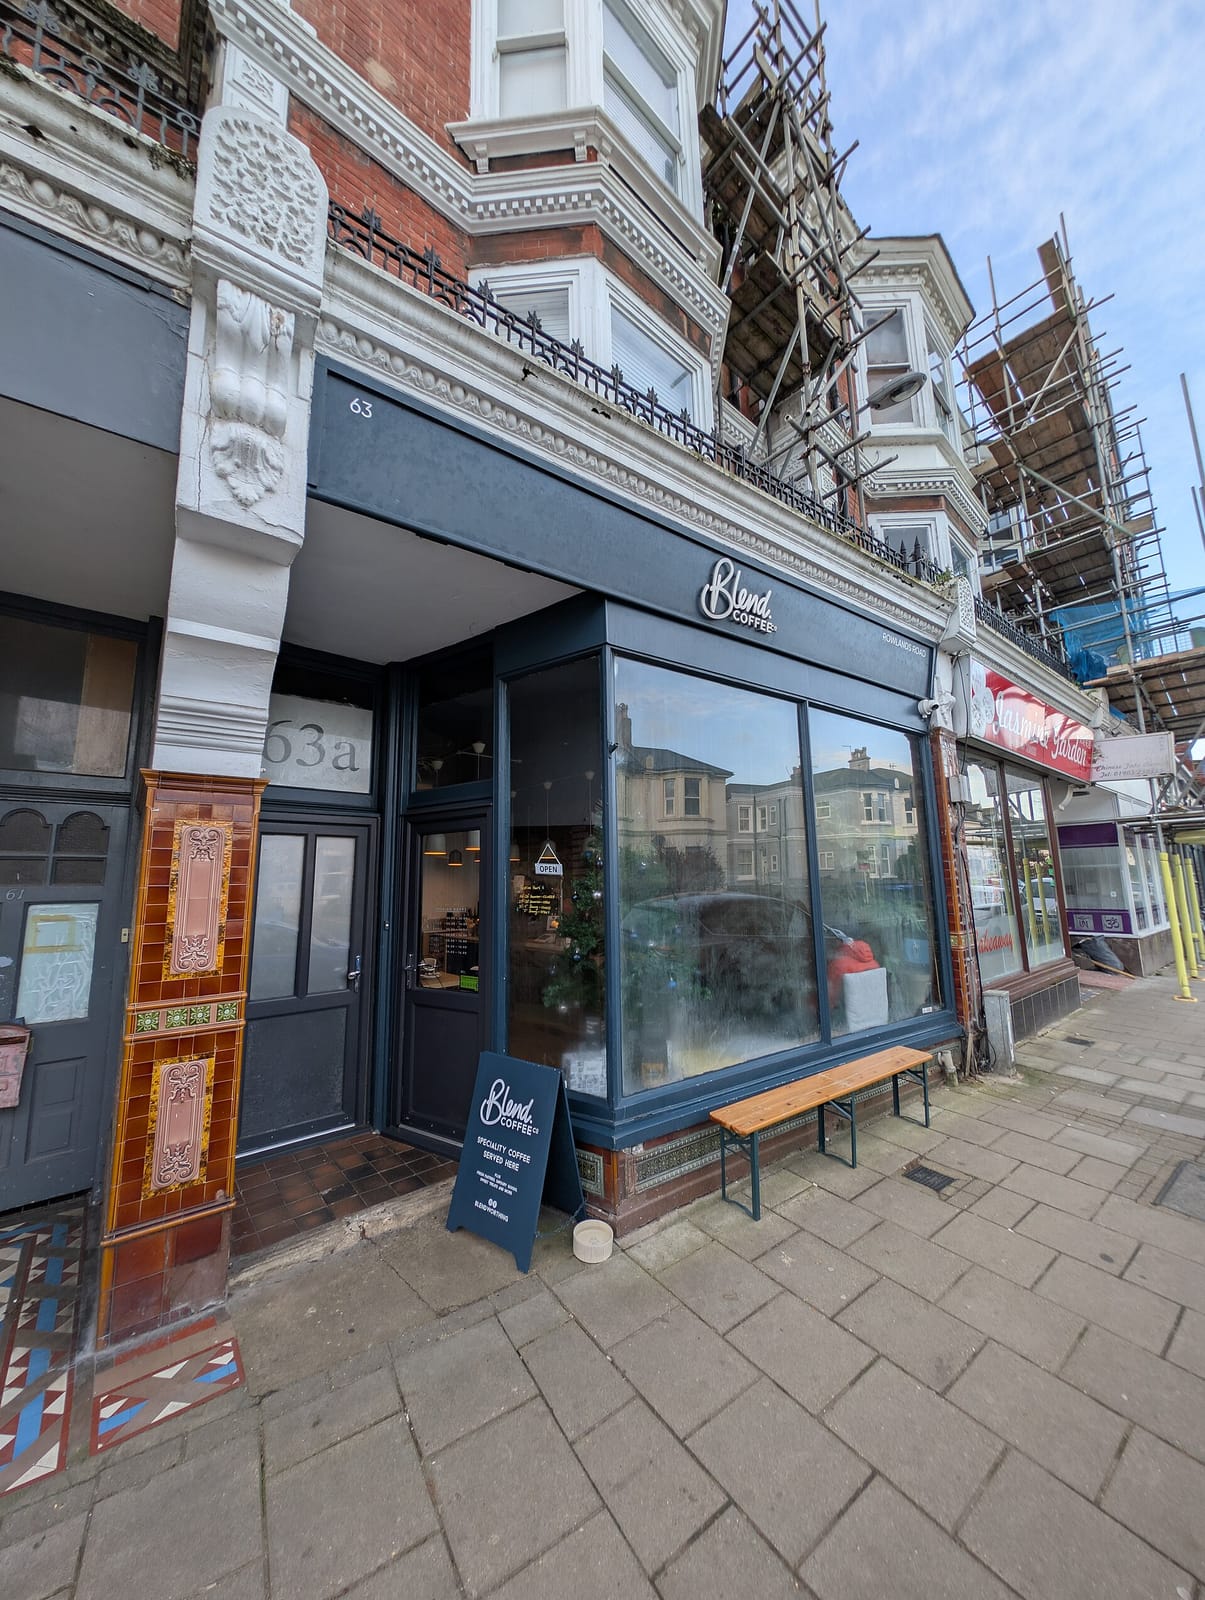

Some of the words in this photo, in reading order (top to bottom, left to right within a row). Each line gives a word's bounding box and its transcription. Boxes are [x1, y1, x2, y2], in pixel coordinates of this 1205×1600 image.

[350, 397, 373, 418] 63
[732, 609, 773, 633] COFFEE
[882, 632, 912, 652] ROWLANDS
[911, 645, 927, 658] ROAD
[263, 720, 360, 771] 63a
[1051, 725, 1087, 767] Garden
[539, 865, 558, 873] OPEN
[6, 888, 25, 901] 61
[975, 928, 1013, 954] akeaway
[500, 1116, 533, 1136] COFFEE
[476, 1136, 507, 1154] SPECIALITY
[507, 1148, 532, 1165] COFFEE
[483, 1150, 504, 1165] SERVED
[504, 1159, 520, 1172] HERE
